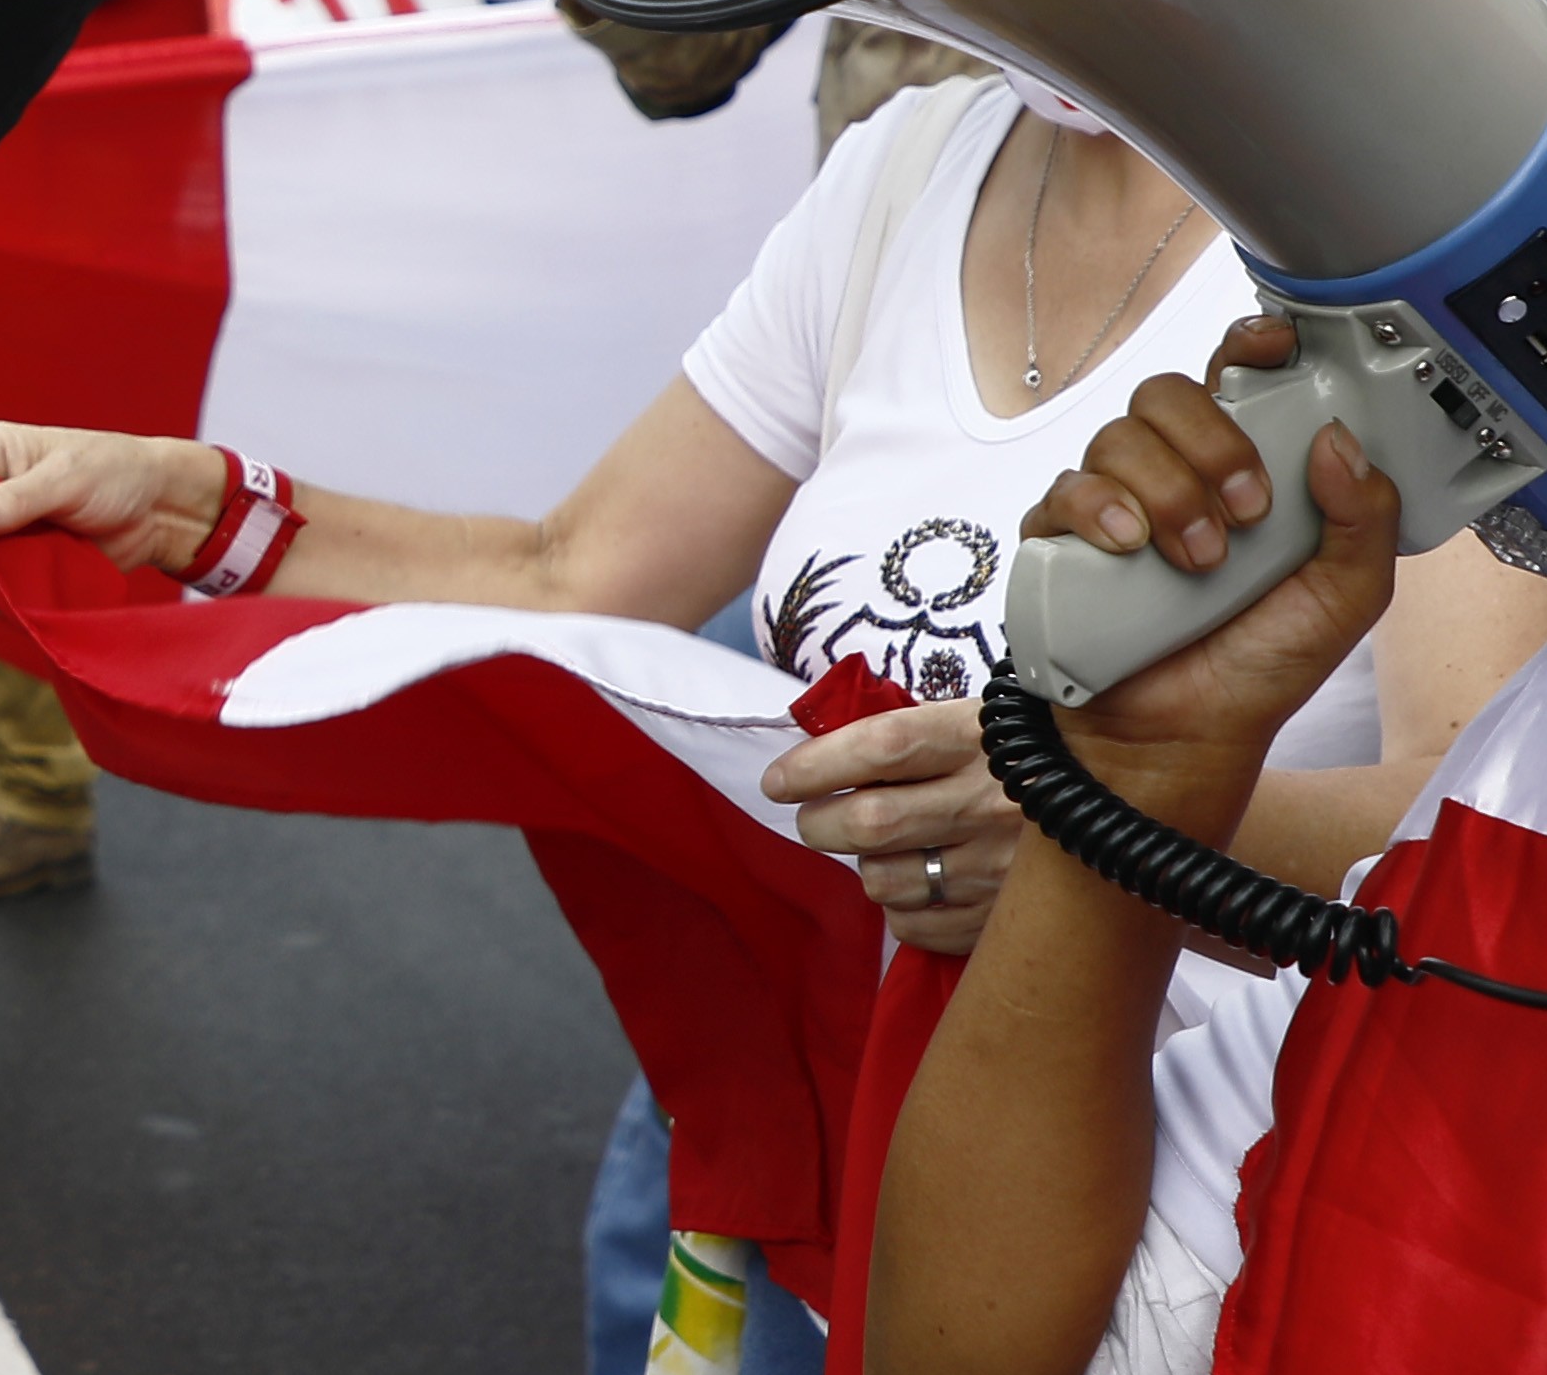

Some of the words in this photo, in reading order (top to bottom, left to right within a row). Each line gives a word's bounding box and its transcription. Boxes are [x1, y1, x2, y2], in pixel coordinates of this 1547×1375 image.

[1435, 348, 1469, 384] USB/SD
[1467, 381, 1491, 402] OFF
[1485, 399, 1509, 423] MIC
